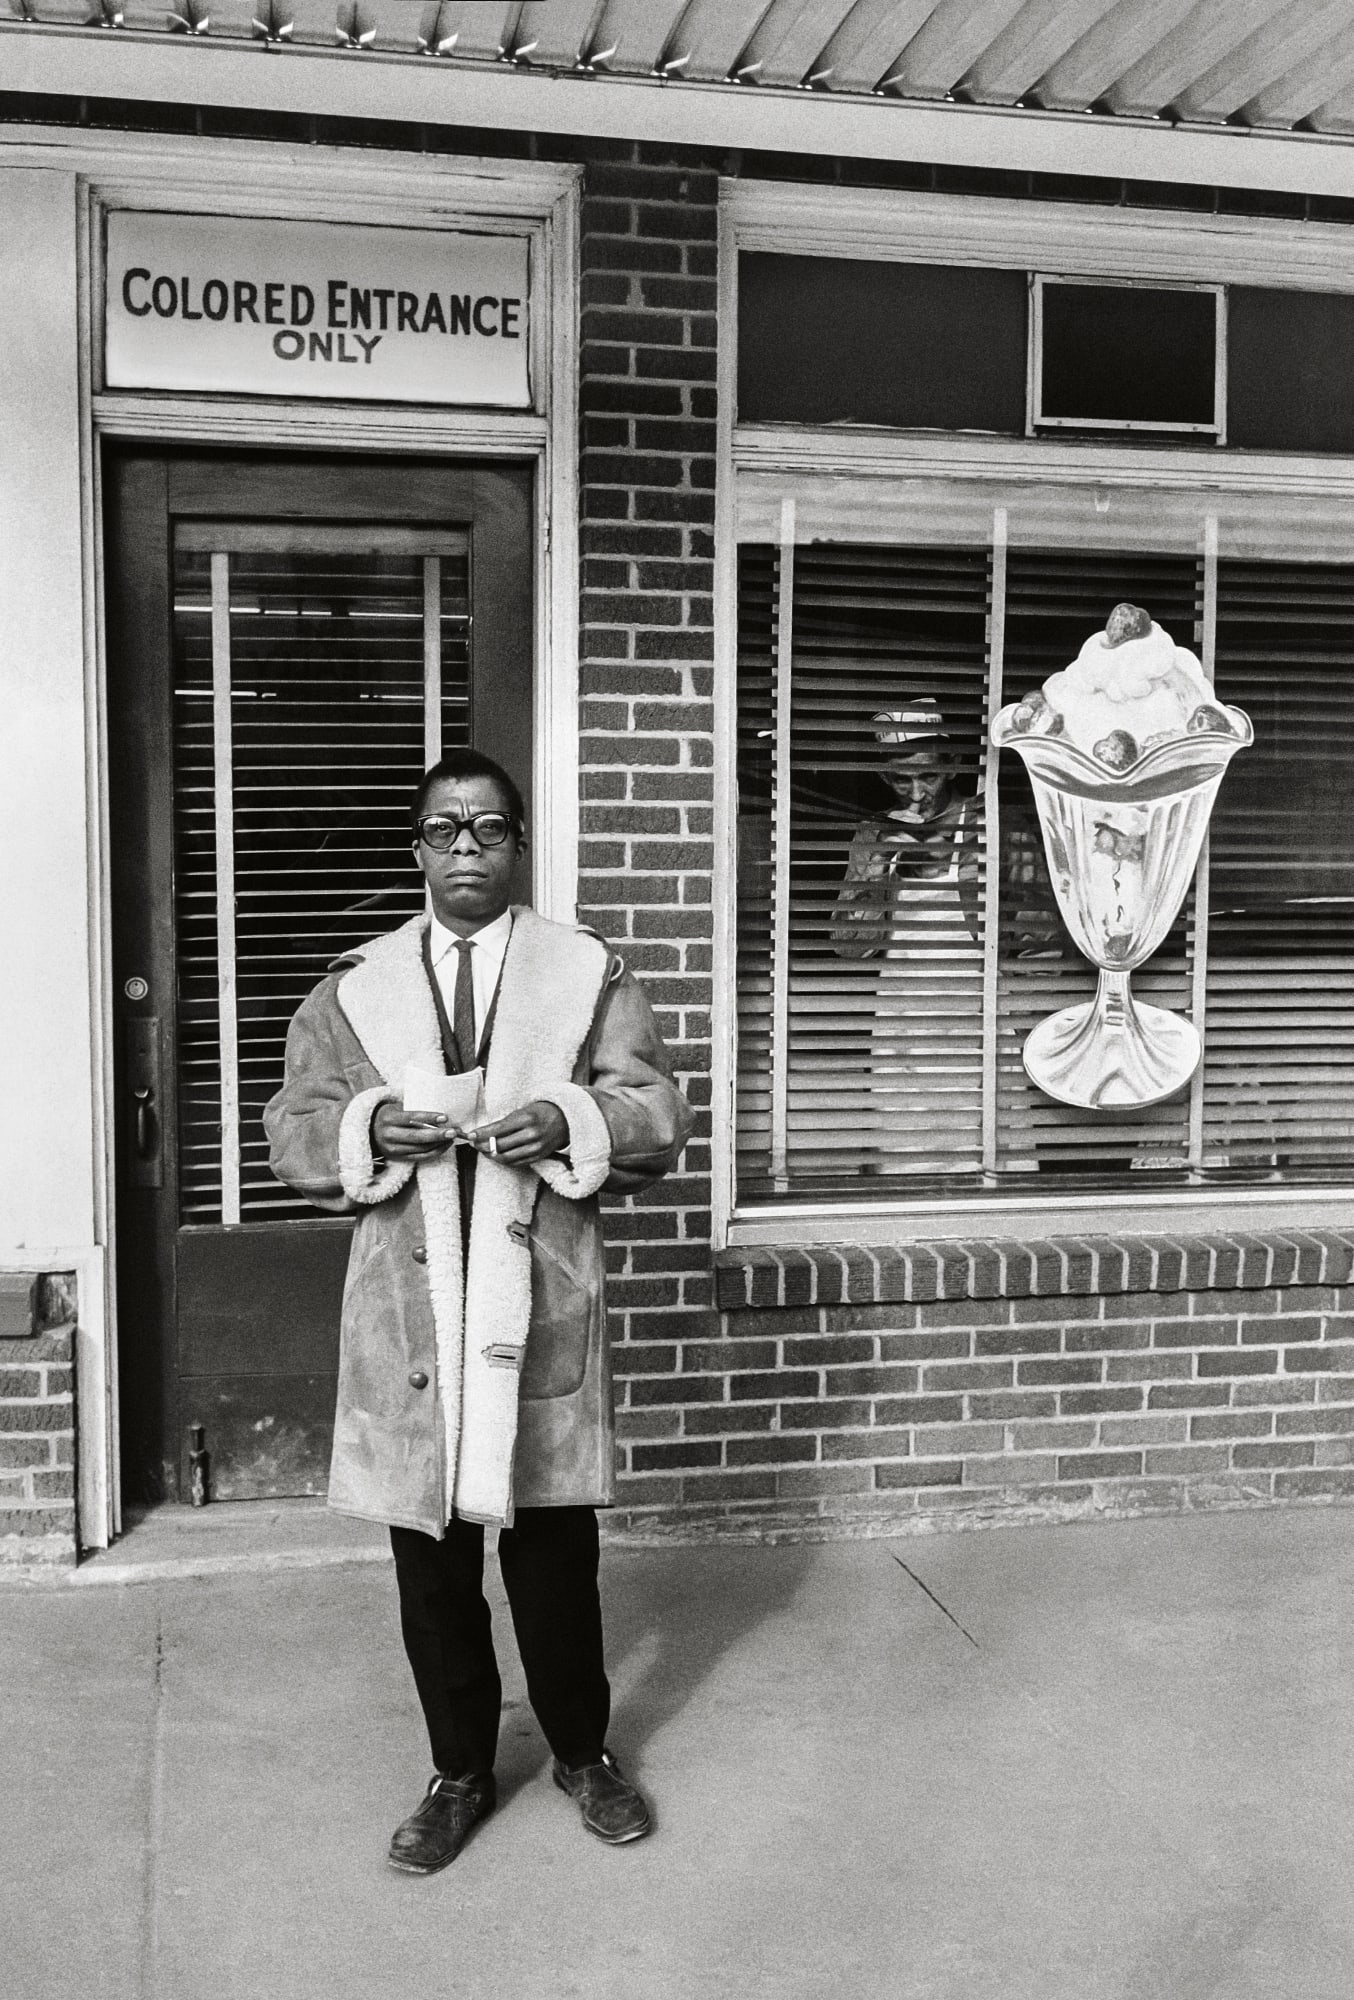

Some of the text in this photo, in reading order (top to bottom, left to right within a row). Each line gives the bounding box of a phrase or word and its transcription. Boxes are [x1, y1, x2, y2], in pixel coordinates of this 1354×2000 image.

[122, 267, 522, 340] COLORED ENTRANCE
[273, 329, 383, 364] ONLY
